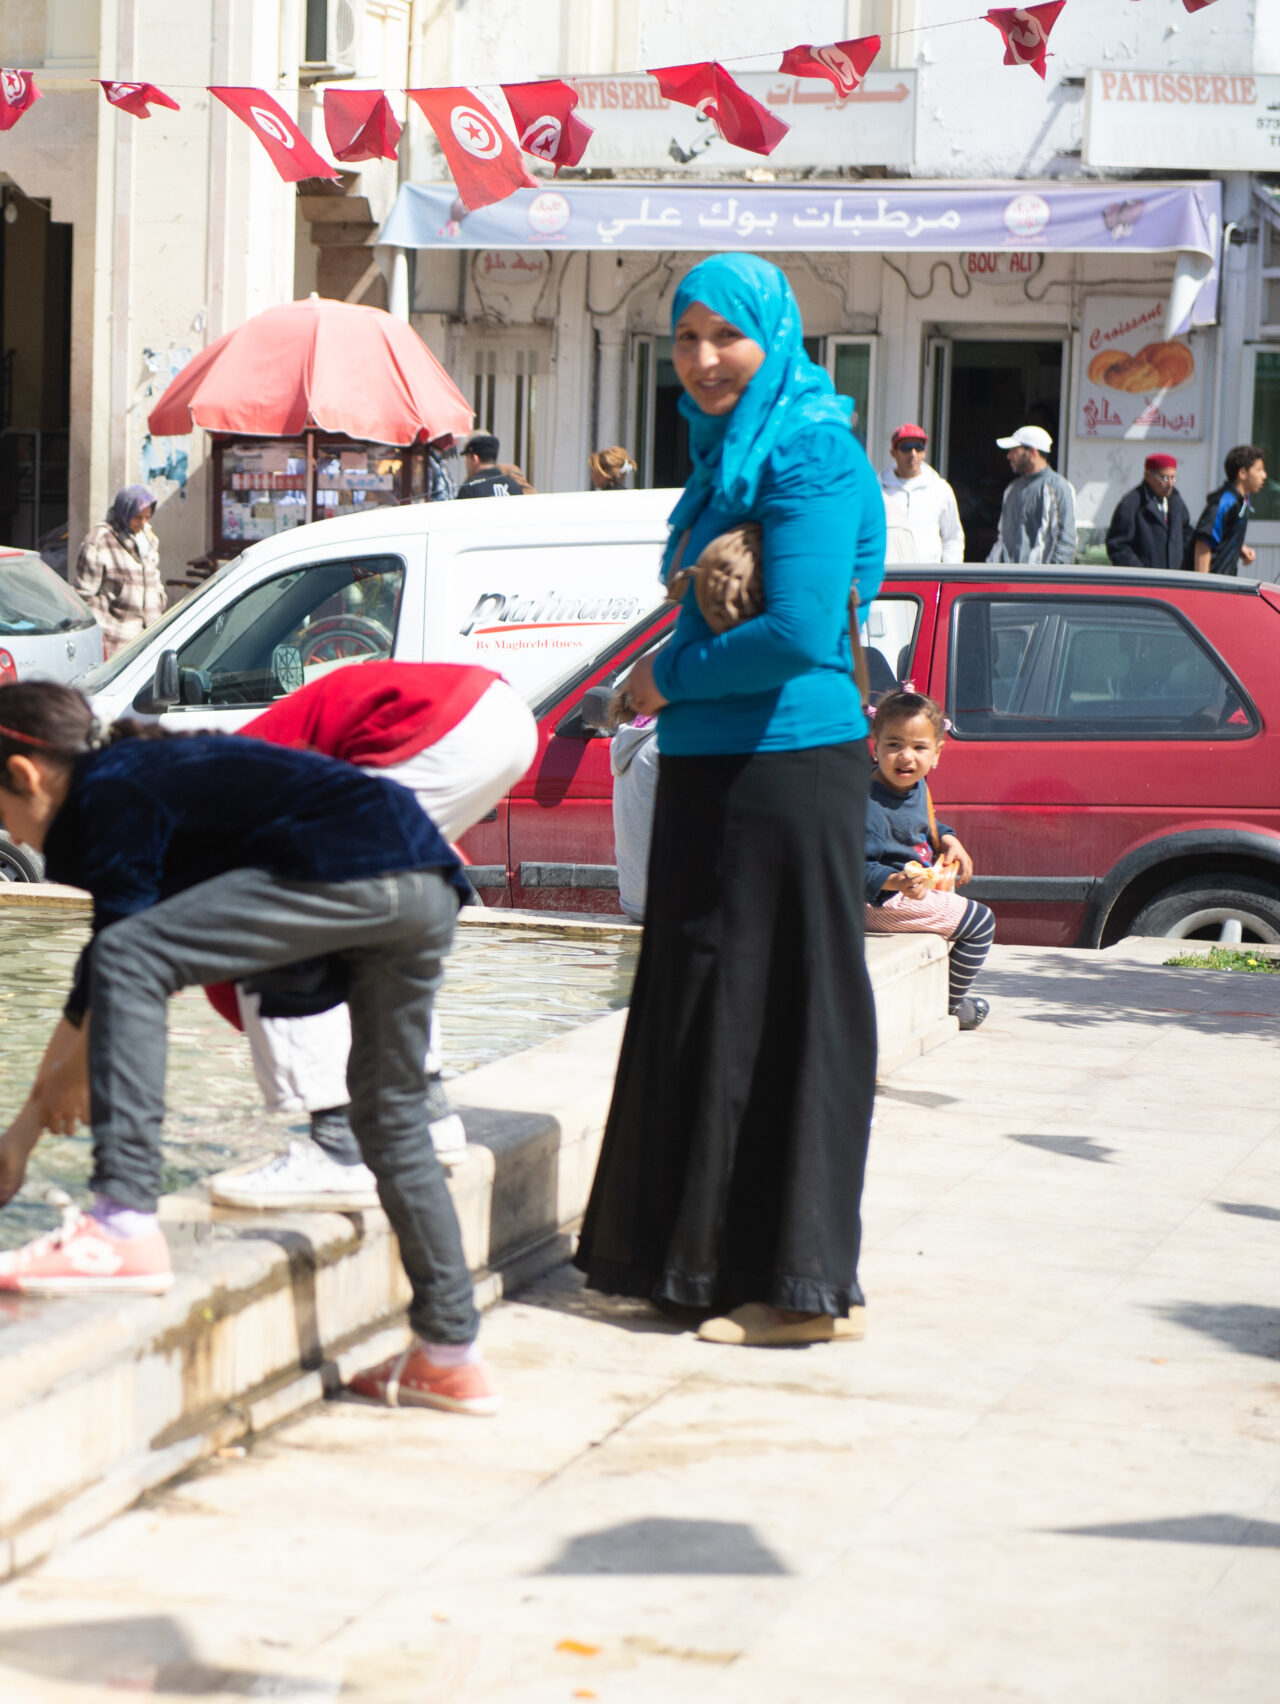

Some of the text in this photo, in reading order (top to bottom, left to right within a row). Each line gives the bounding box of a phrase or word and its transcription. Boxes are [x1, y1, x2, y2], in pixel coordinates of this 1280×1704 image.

[1100, 72, 1258, 105] PATISSERIE
[596, 198, 683, 243] علي
[698, 198, 778, 236] بوك
[793, 198, 962, 238] مرطبات
[1009, 252, 1033, 273] ALI
[1088, 303, 1164, 351] Croissant
[476, 639, 490, 651] By
